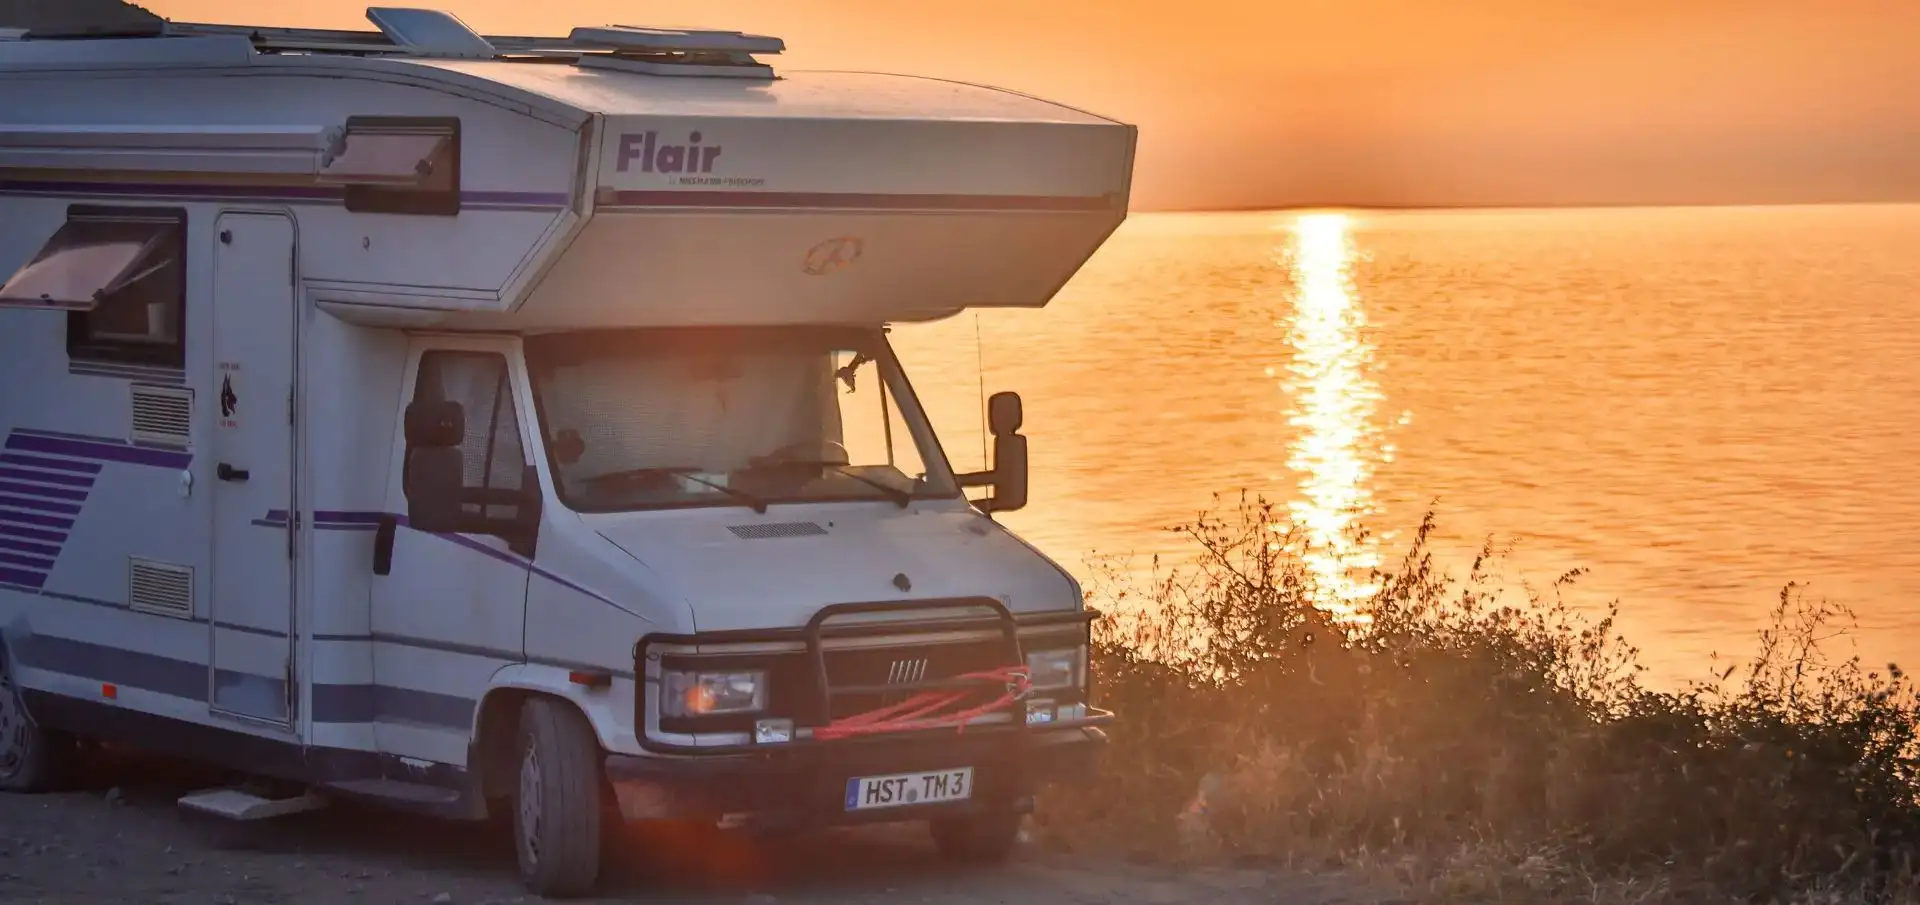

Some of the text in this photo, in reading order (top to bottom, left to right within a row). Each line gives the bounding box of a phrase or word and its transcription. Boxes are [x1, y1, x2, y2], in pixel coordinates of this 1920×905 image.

[616, 130, 722, 173] Flair
[866, 772, 964, 804] HST TM 3
